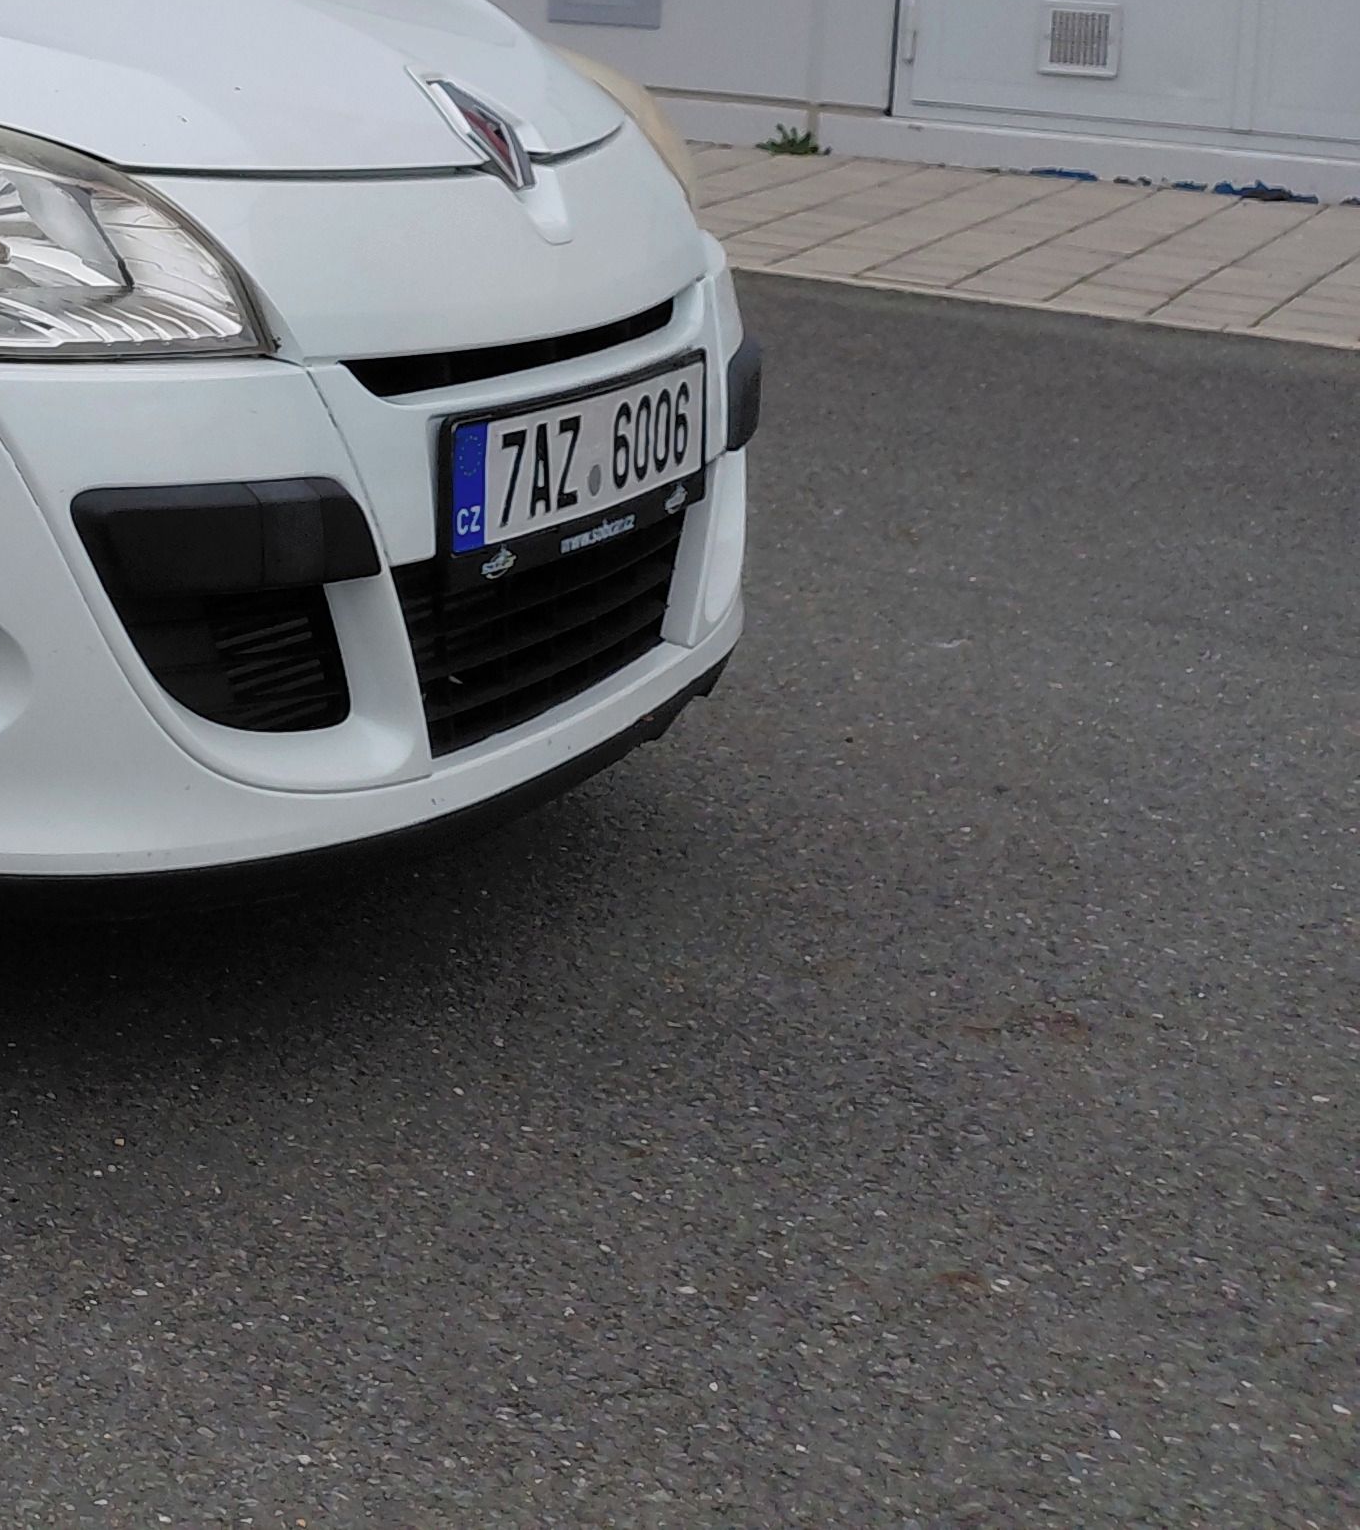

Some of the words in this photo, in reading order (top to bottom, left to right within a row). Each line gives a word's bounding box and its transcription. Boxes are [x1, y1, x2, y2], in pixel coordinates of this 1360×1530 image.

[498, 415, 582, 529] 7AZ
[611, 381, 690, 490] 6006
[456, 505, 481, 536] CZ
